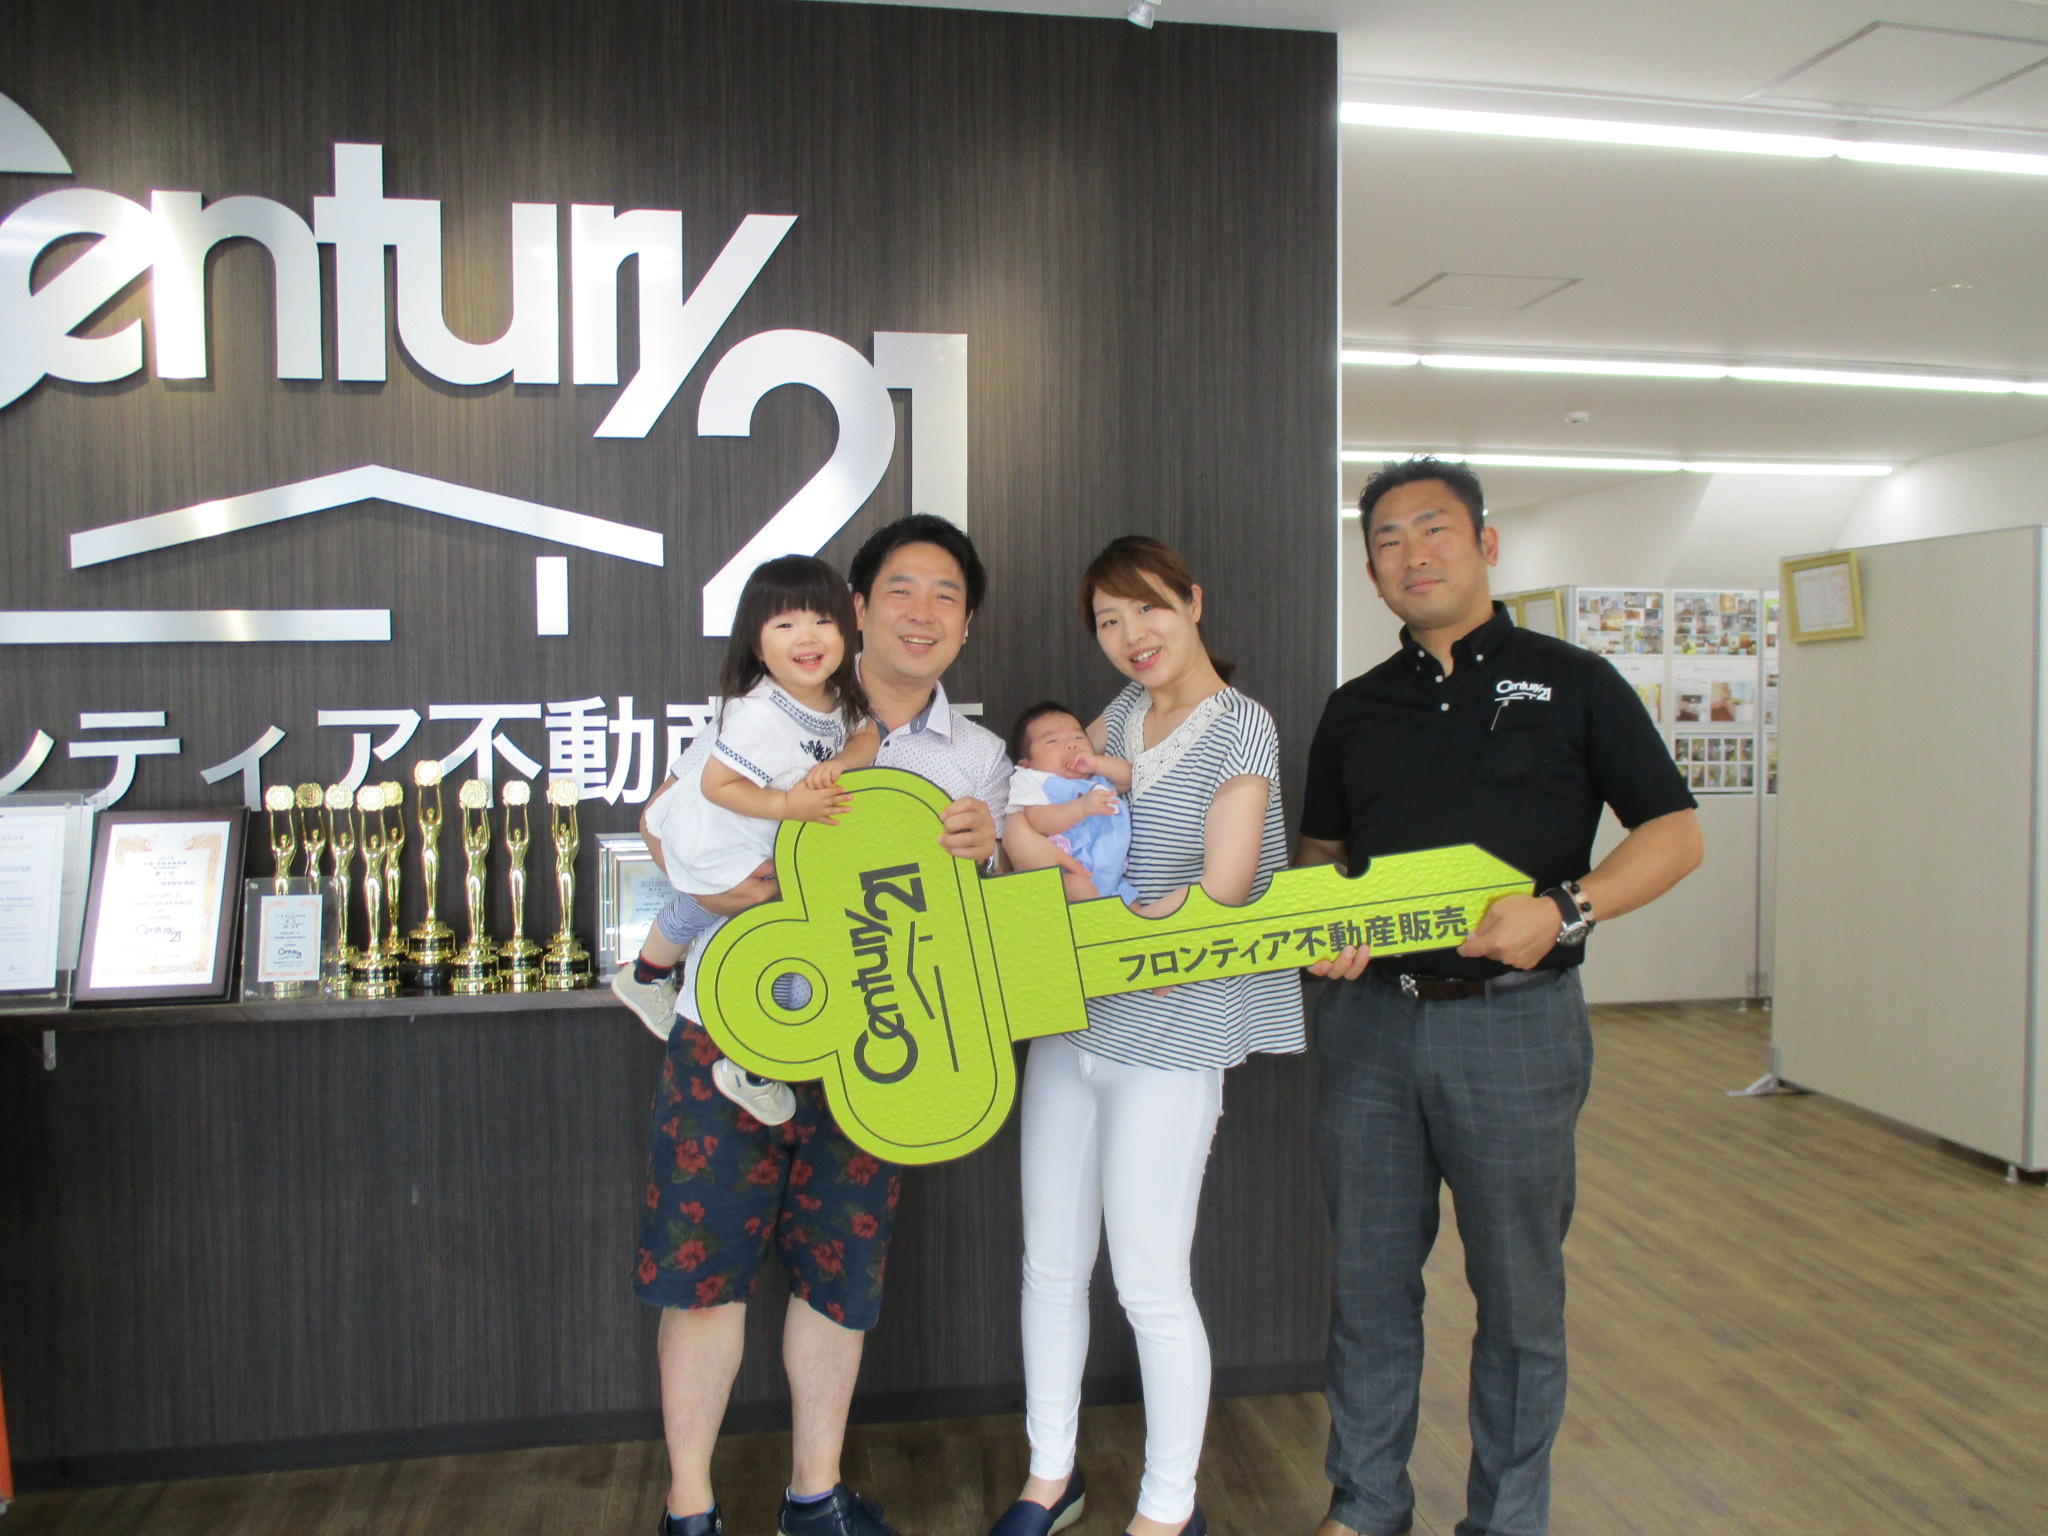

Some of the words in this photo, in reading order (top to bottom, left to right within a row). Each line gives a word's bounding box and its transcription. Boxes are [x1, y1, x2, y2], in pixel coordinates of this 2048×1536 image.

[697, 328, 968, 637] 21
[1496, 679, 1544, 694] Century
[1536, 687, 1552, 701] 21
[858, 862, 927, 921] 21
[1119, 905, 1469, 983] フロンティア不動産販売
[844, 908, 918, 1085] Century
